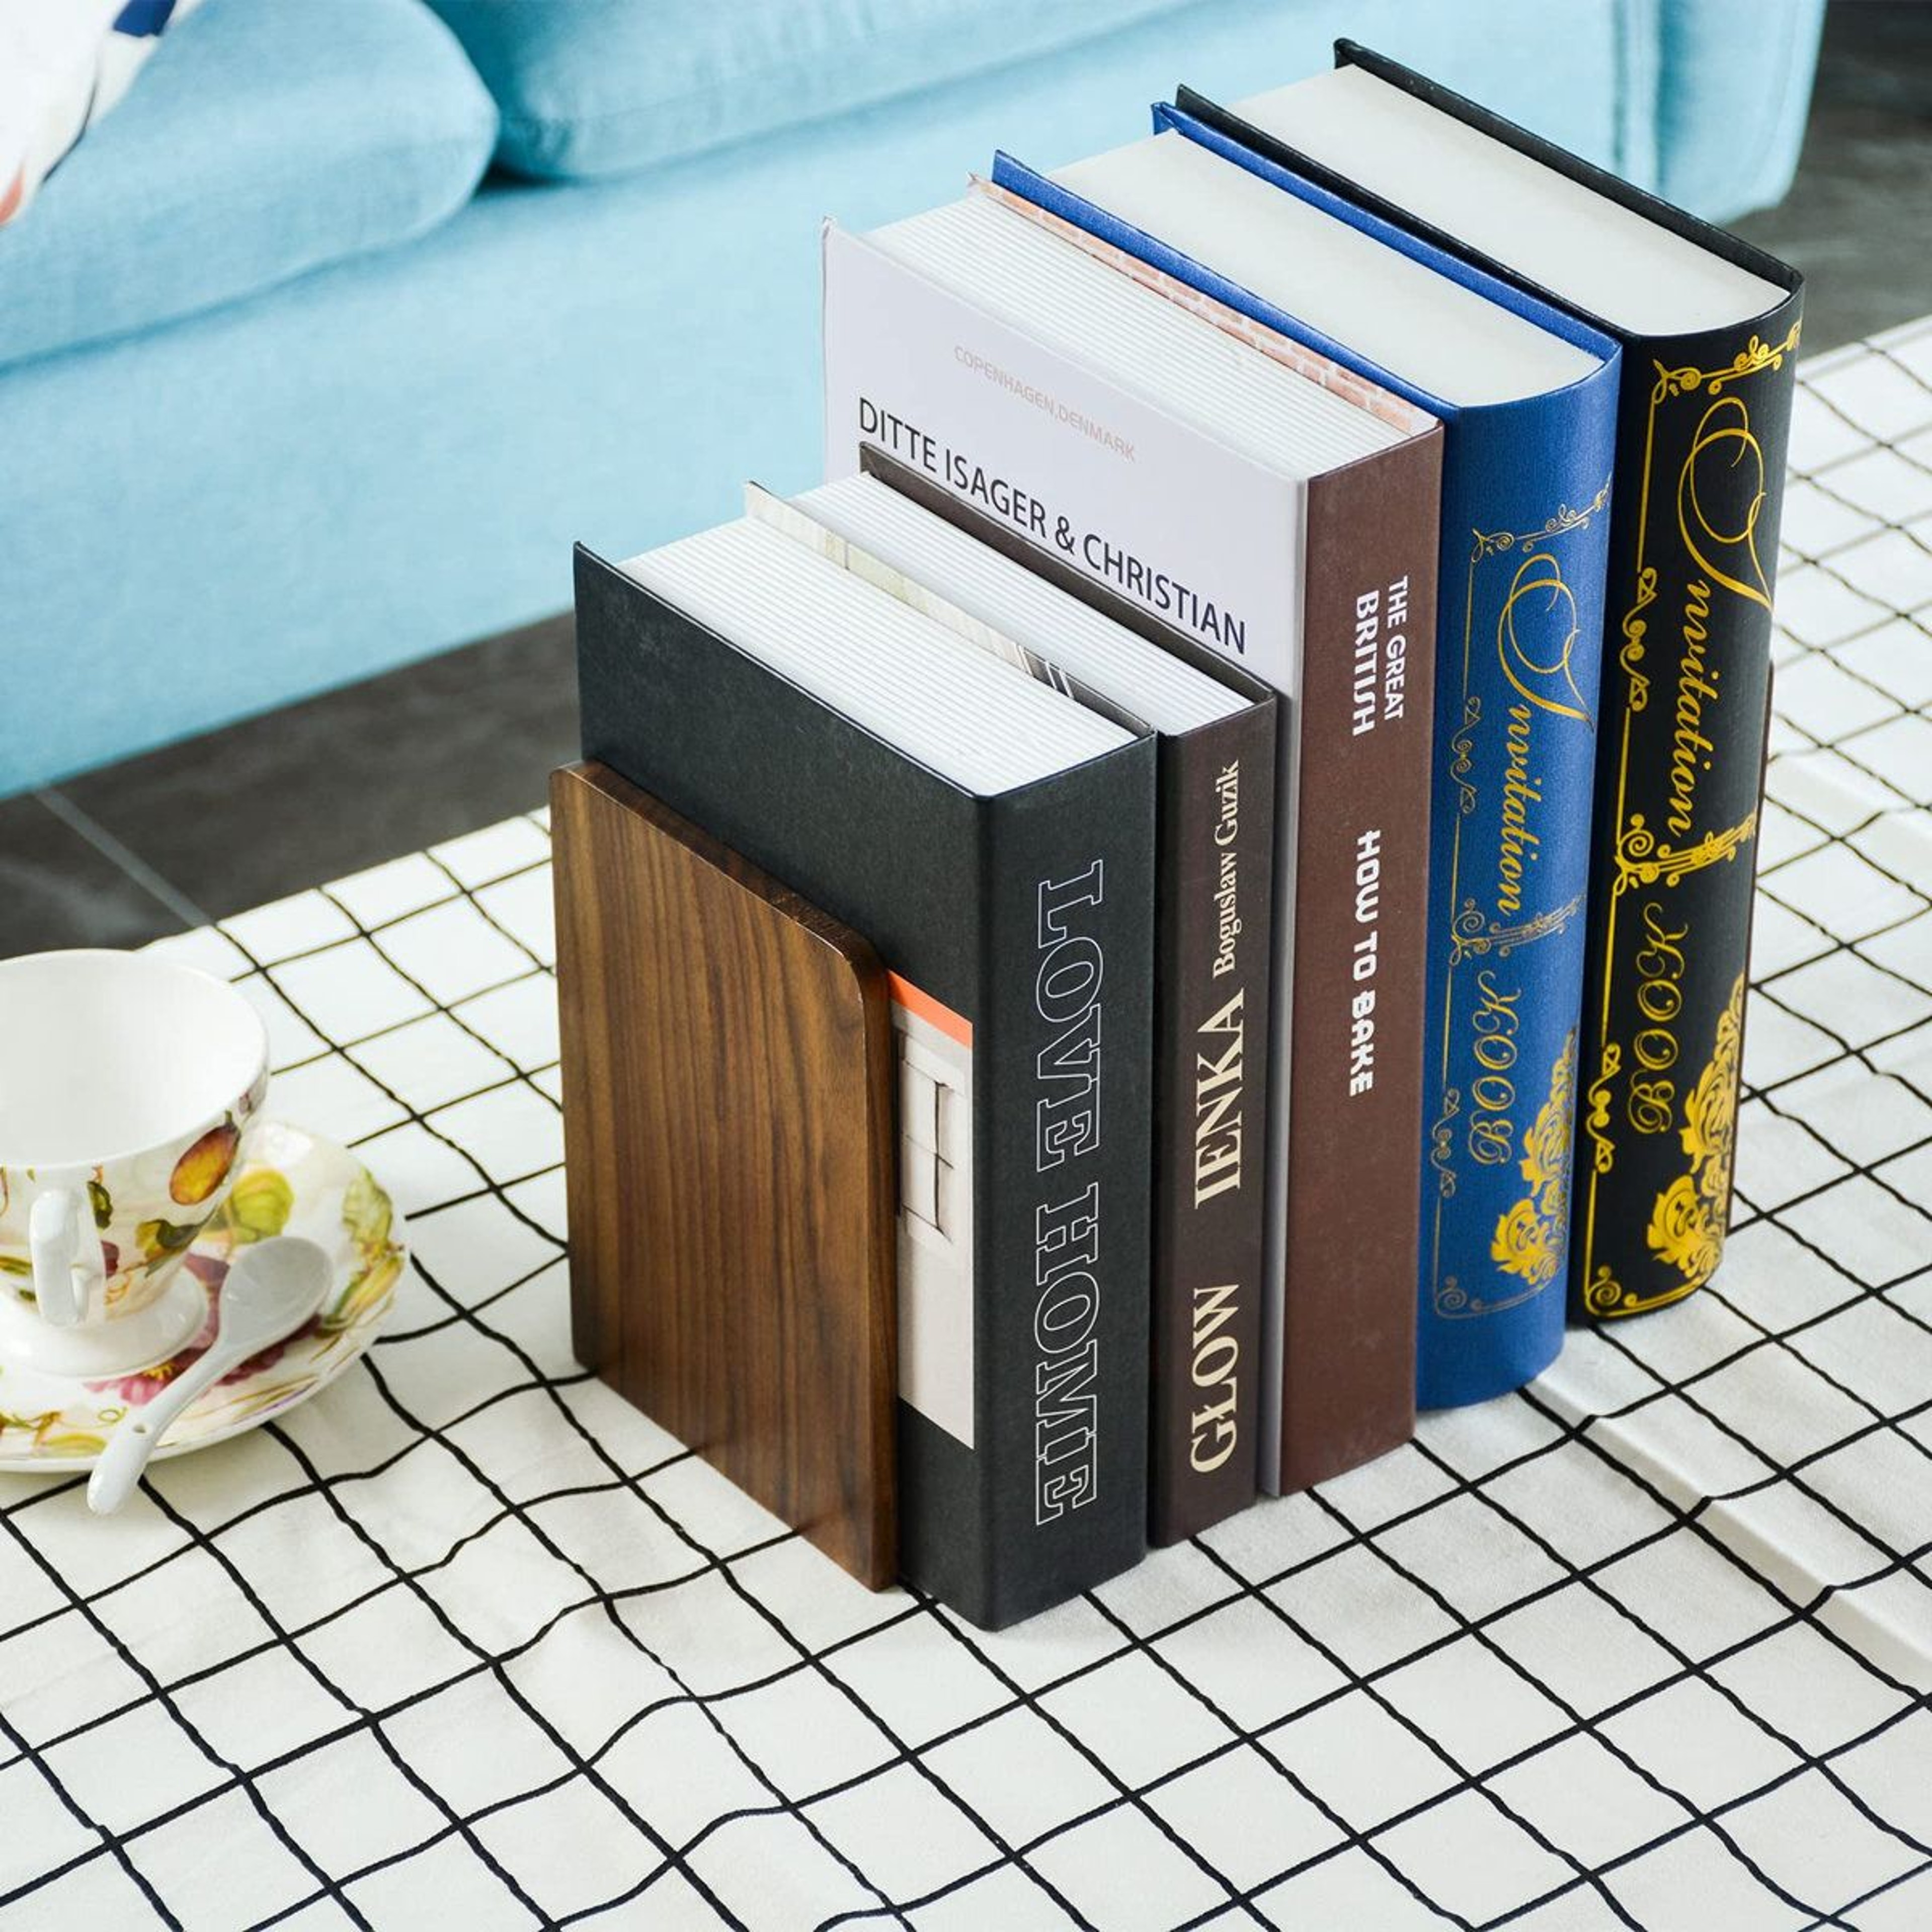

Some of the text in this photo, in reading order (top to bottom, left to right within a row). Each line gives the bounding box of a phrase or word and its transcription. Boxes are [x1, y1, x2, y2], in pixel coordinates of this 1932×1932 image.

[859, 397, 1245, 655] DITTE ISAGER & CHRISTIAN
[1384, 575, 1408, 720] THE GREAT
[1667, 396, 1774, 839] Invitation
[1352, 589, 1379, 737] BRITISH
[1496, 552, 1594, 918] Invitation
[1214, 759, 1239, 846] Guzik
[1349, 829, 1381, 1097] HOW TO BAKE
[1467, 970, 1522, 1165] BOOK
[1627, 901, 1689, 1134] BOOK
[1033, 858, 1104, 1526] LOVE HOME
[1190, 987, 1244, 1473] GŁOW IENKA
